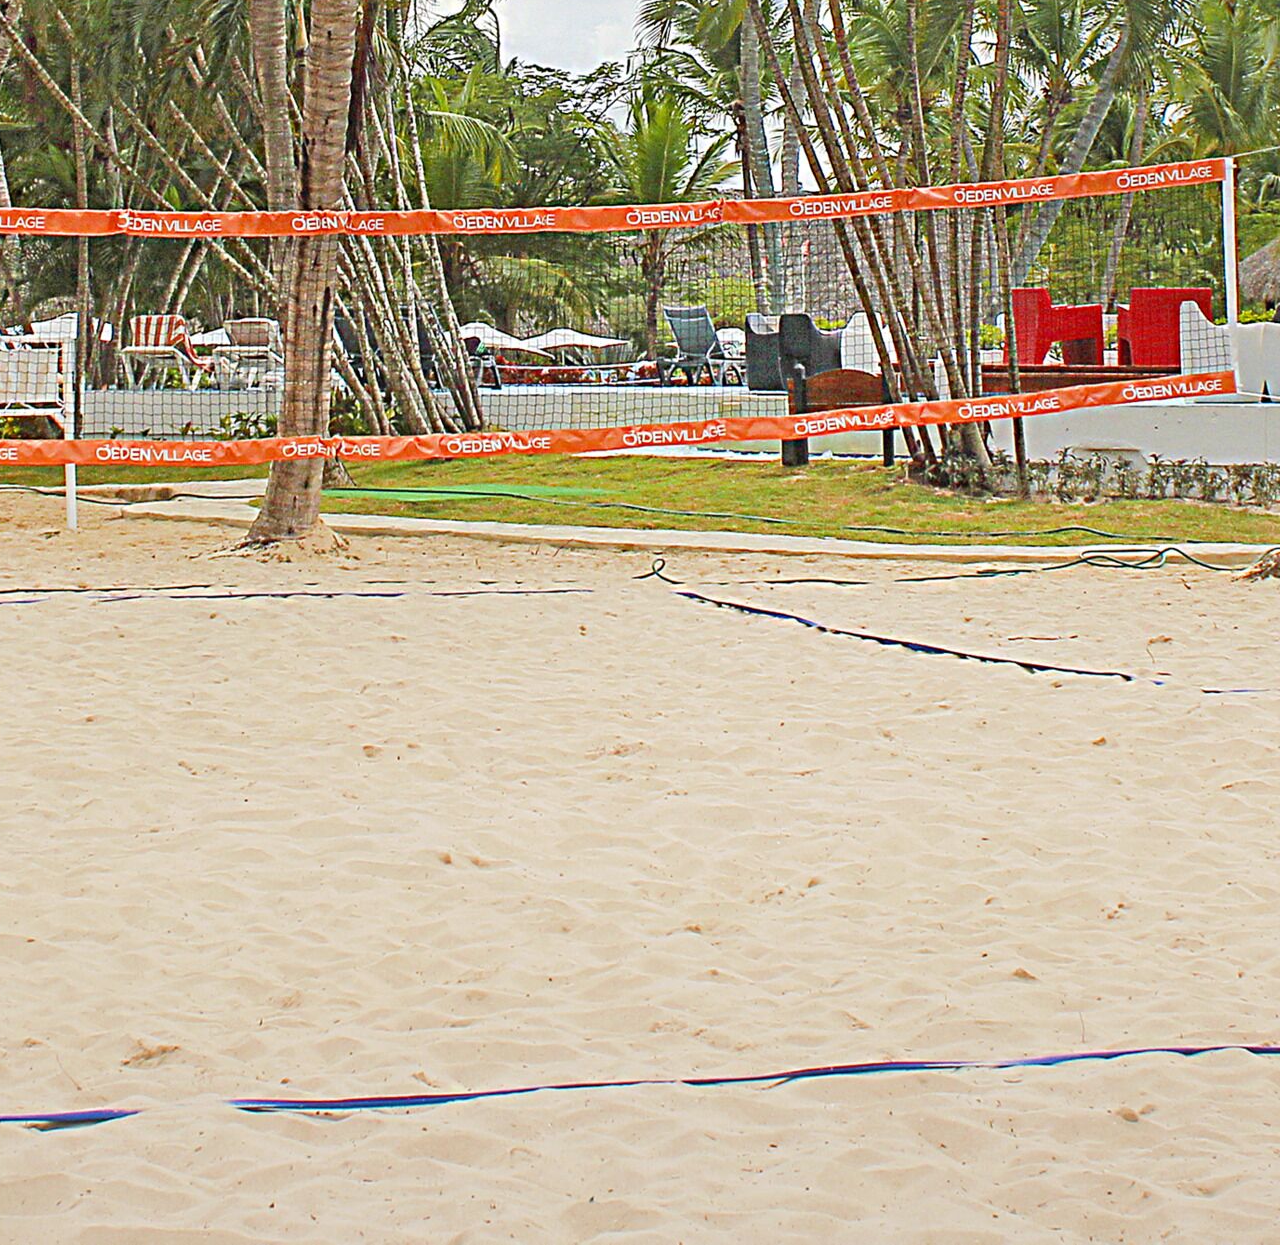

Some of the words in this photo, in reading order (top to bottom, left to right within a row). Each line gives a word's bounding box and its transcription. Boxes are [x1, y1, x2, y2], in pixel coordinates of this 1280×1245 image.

[1130, 173, 1165, 188] EDEN
[1165, 166, 1212, 182] VILLAGE
[965, 188, 1002, 202] EDEN
[1002, 183, 1054, 199] VILLAGE
[804, 200, 841, 215] EDEN
[841, 196, 893, 212] VILLAGE
[467, 215, 504, 229] EDEN
[641, 210, 680, 224] EDEN
[163, 219, 222, 232] VILLAGE
[1136, 384, 1172, 399] EDEN
[1172, 379, 1222, 395] VILLAGE
[973, 402, 1010, 417] EDEN
[673, 425, 726, 441] VILLAGE
[808, 418, 846, 433] EDEN
[463, 438, 501, 453] EDEN
[111, 447, 152, 461] EDEN
[153, 448, 212, 462] VILLAGE
